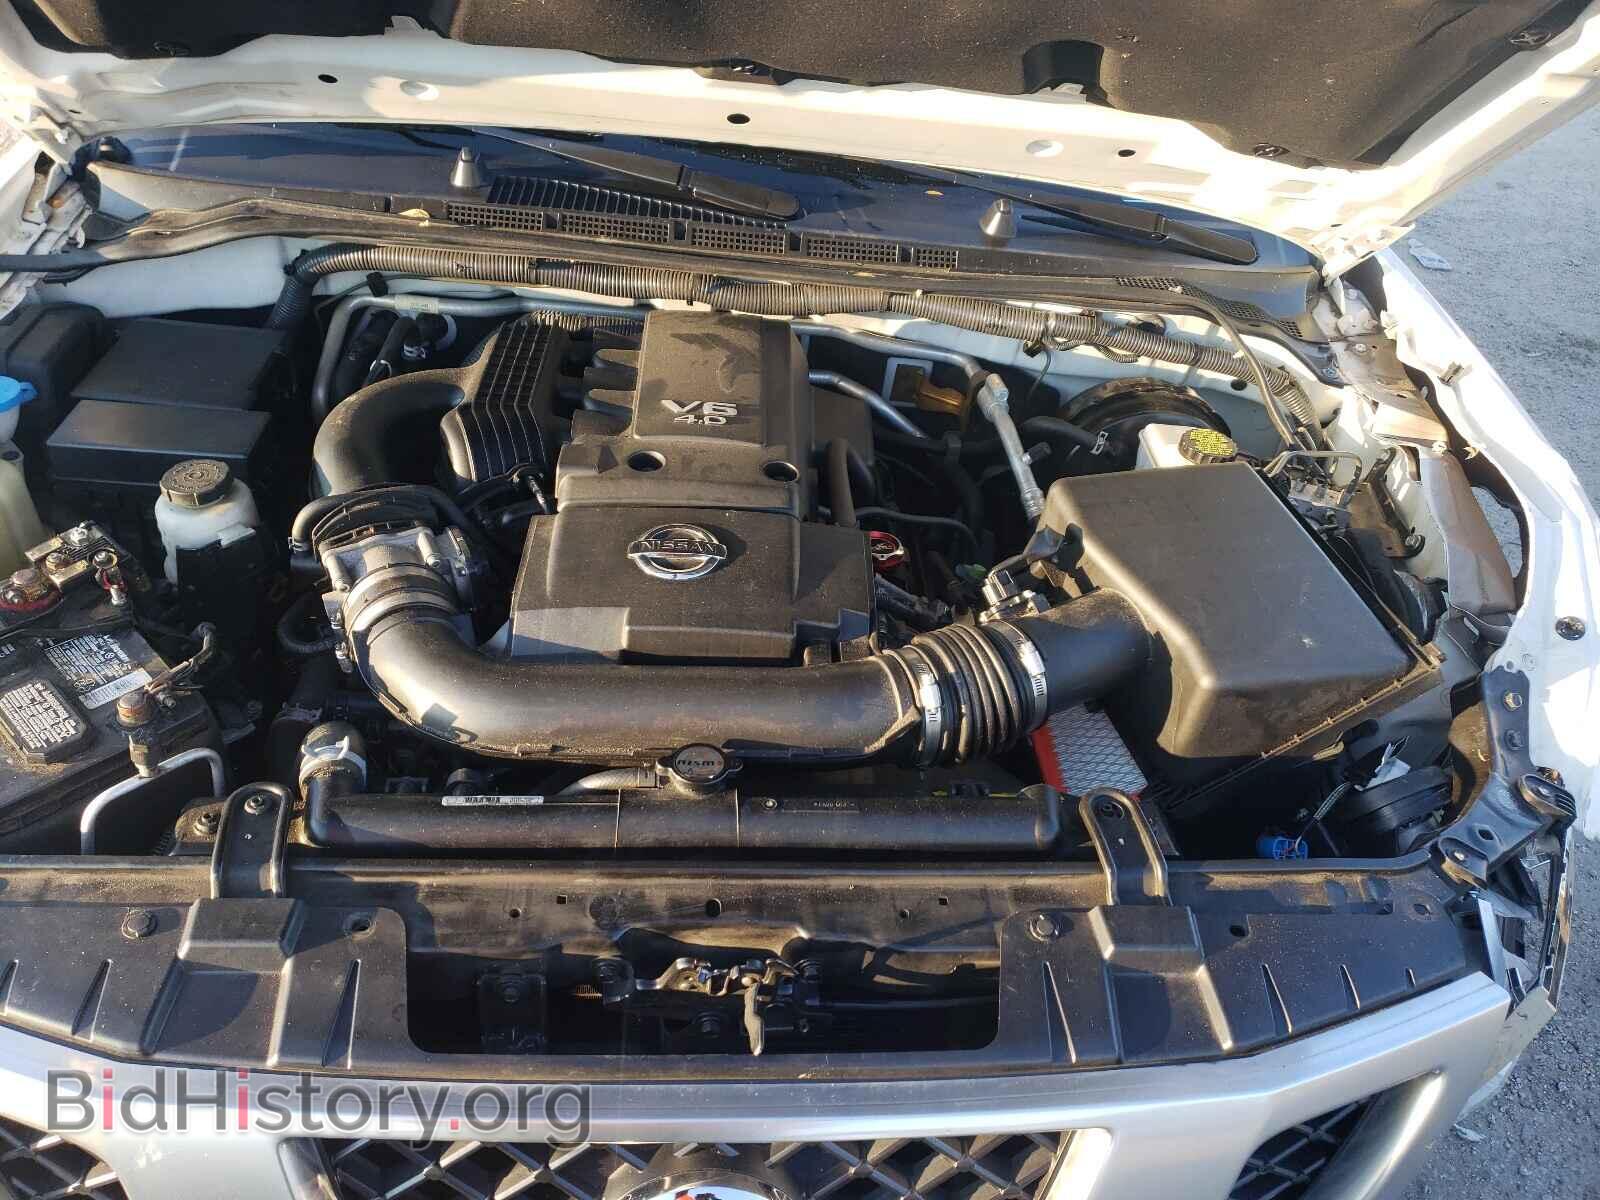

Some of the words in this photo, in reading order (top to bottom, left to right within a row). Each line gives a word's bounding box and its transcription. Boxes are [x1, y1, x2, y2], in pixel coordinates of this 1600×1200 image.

[661, 399, 738, 416] V6
[674, 415, 727, 425] 4.0
[640, 540, 717, 553] NISSAN
